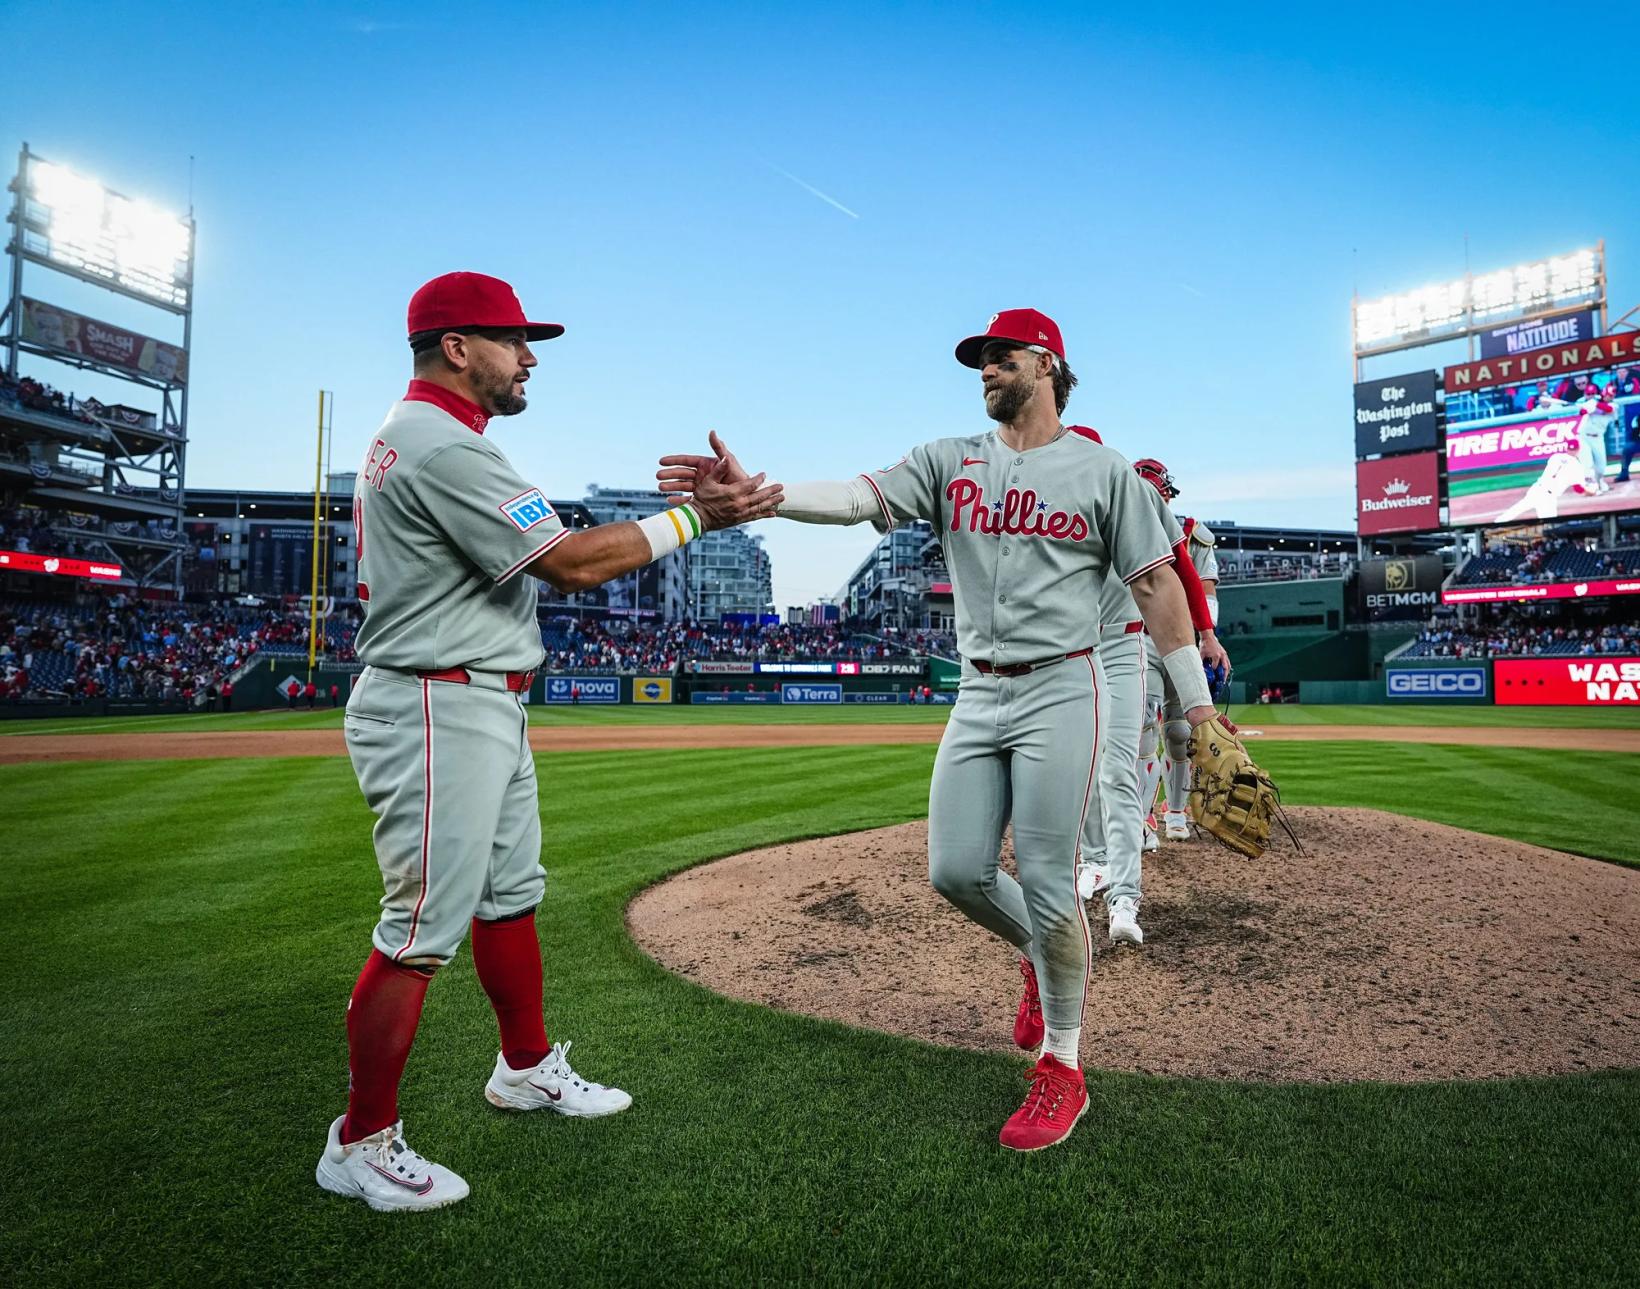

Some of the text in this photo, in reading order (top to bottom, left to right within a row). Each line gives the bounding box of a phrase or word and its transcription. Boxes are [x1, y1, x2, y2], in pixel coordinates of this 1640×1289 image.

[1506, 318, 1579, 352] NATITUDE
[1381, 387, 1406, 402] The
[1357, 401, 1433, 424] Washington
[1379, 422, 1410, 443] Post
[1501, 421, 1578, 450] RACK
[945, 478, 1089, 542] Phillies
[1362, 495, 1432, 512] Budweiser
[510, 498, 553, 529] IBX
[1366, 591, 1437, 607] BETMGM
[892, 664, 920, 674] FAN
[571, 680, 615, 693] Inova
[1389, 673, 1483, 692] GEICO
[802, 688, 838, 700] Terra
